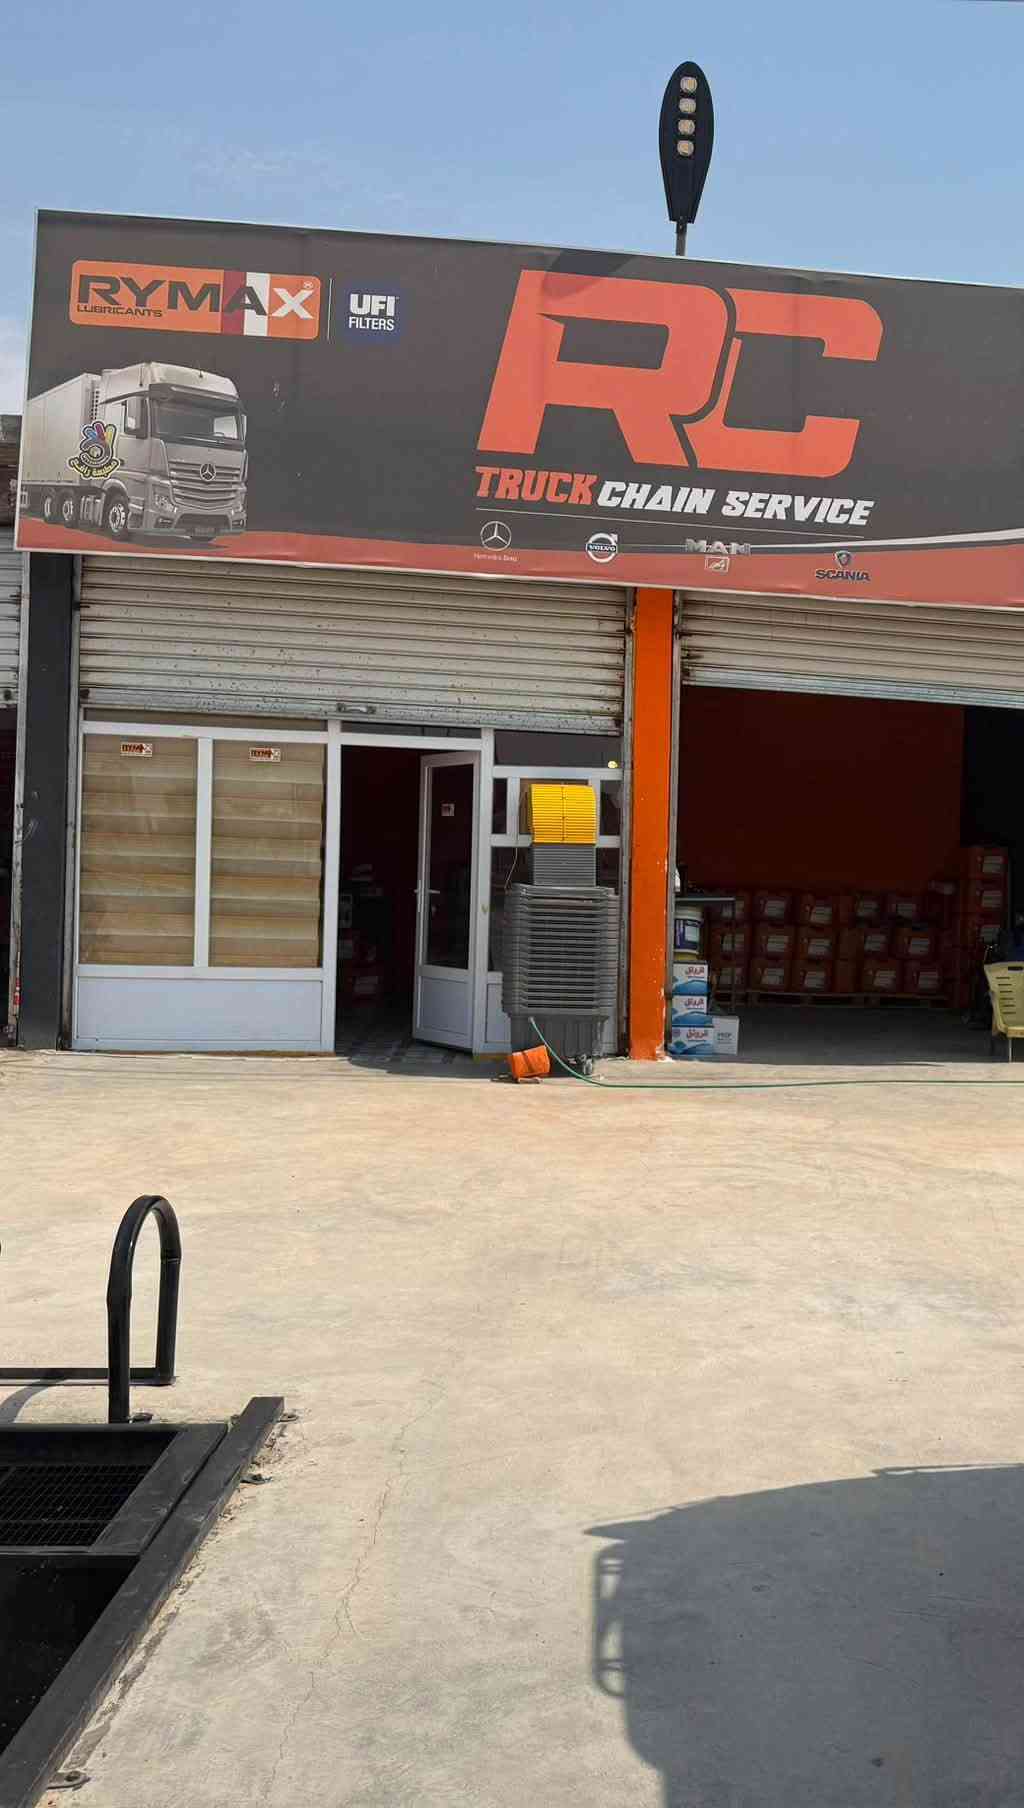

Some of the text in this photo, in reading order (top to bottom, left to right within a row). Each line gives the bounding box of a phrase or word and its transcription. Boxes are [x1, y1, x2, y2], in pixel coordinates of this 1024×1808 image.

[78, 274, 315, 319] RYMAX
[348, 293, 396, 317] UFI
[76, 303, 163, 318] LUBRICANTS
[348, 316, 395, 331] FILTERS
[477, 269, 884, 478] RC
[475, 465, 875, 526] TRUCK CHAIN SERVICE
[588, 543, 616, 552] VOLVO
[685, 538, 751, 555] MAN
[815, 569, 871, 581] SCANIA
